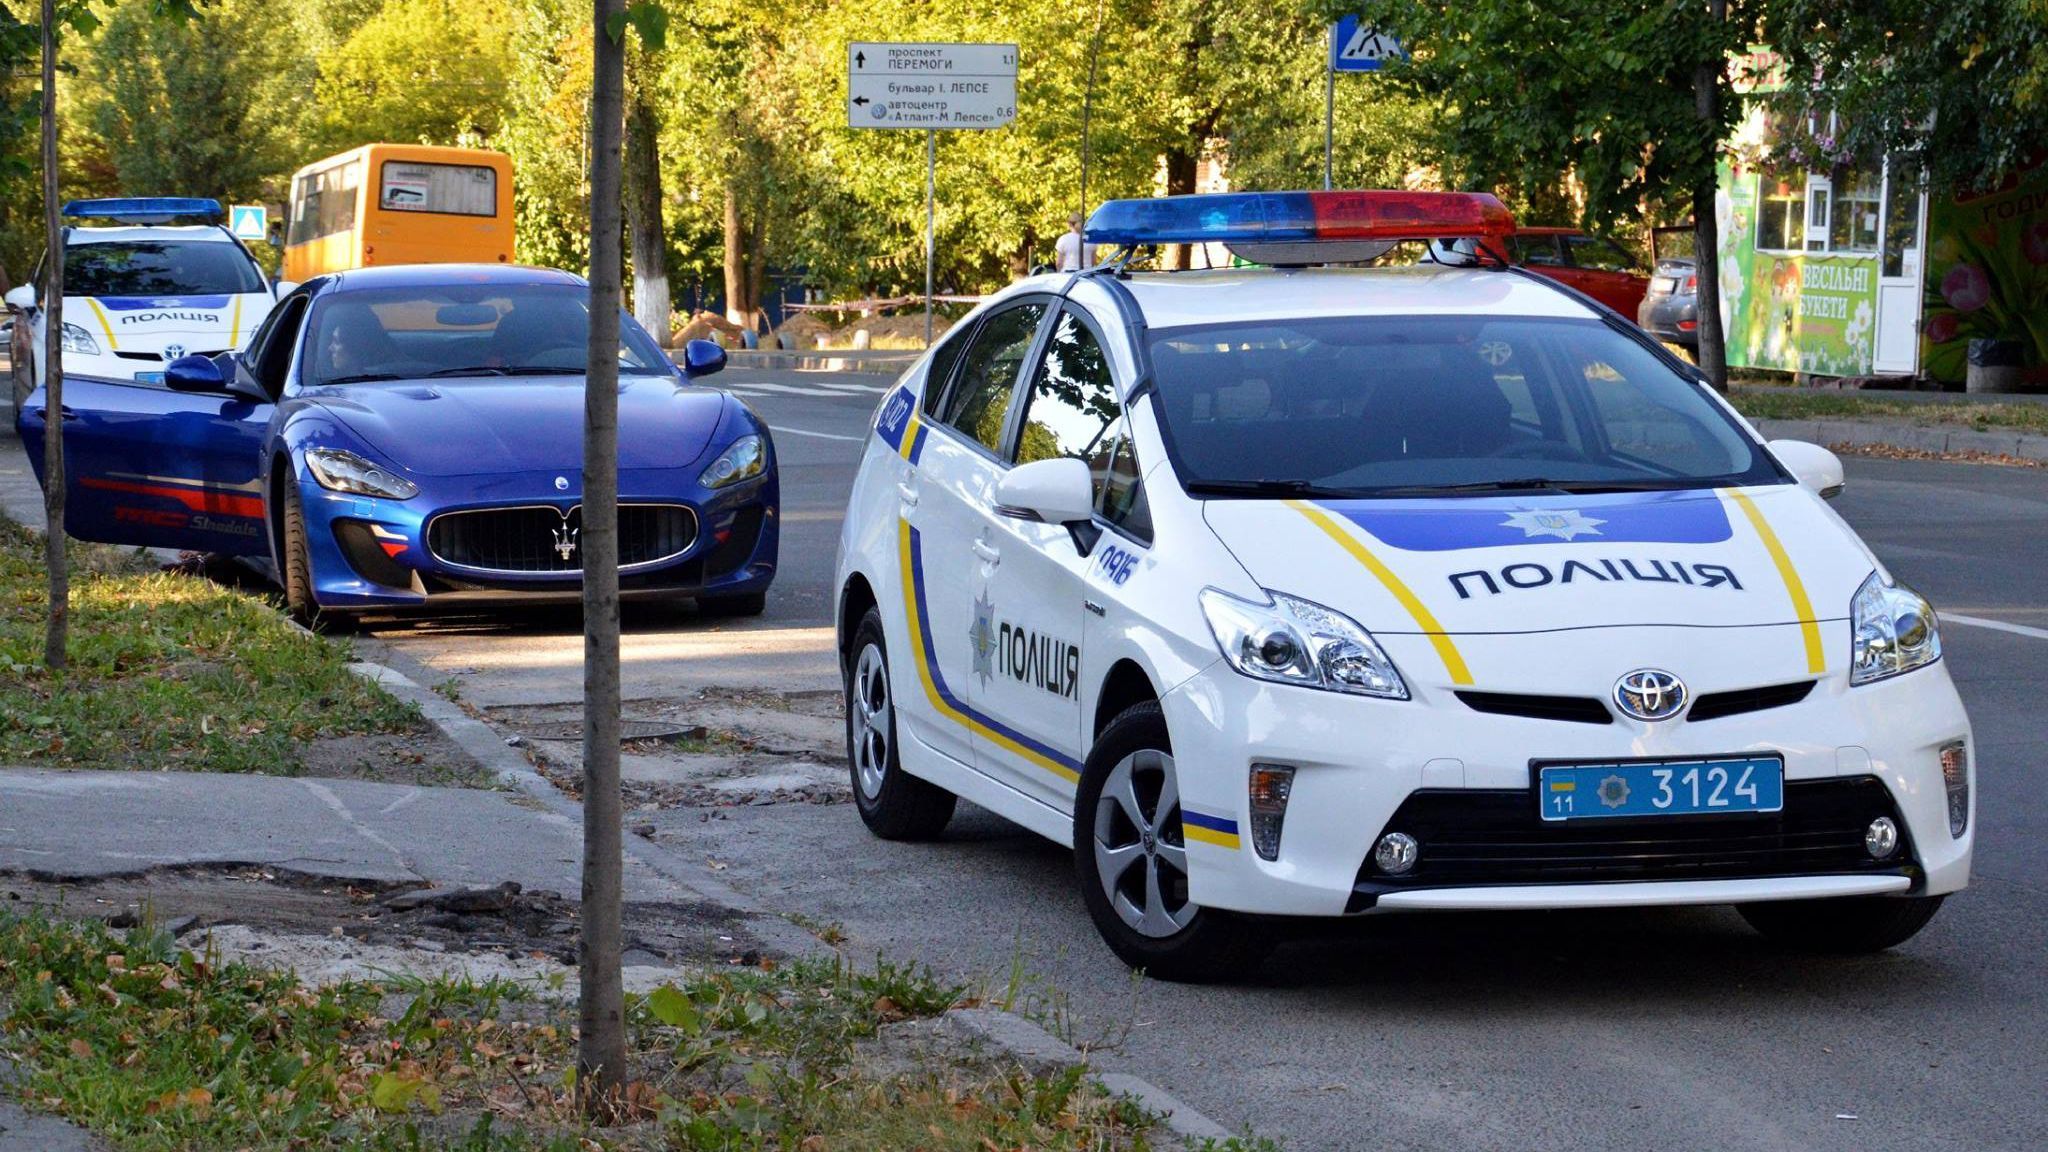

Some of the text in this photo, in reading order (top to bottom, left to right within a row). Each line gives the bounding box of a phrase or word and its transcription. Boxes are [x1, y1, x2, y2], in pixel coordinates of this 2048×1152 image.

[888, 49, 943, 58] проспект
[888, 59, 953, 70] ПЕРЕМОГИ
[888, 82, 935, 95] бульвар
[950, 83, 989, 94] ЛЕПСЕ
[888, 101, 947, 110] автоцентр
[1803, 264, 1869, 293] ВЕСІЛЬНІ
[1798, 294, 1848, 319] БУКЕТИ
[121, 312, 219, 325] ПОЛІЦІЯ
[1447, 559, 1745, 599] ПОЛІЦІЯ
[1000, 621, 1079, 701] ПОЛІЦІЯ
[1652, 765, 1757, 809] 3124
[1553, 795, 1573, 813] 11
